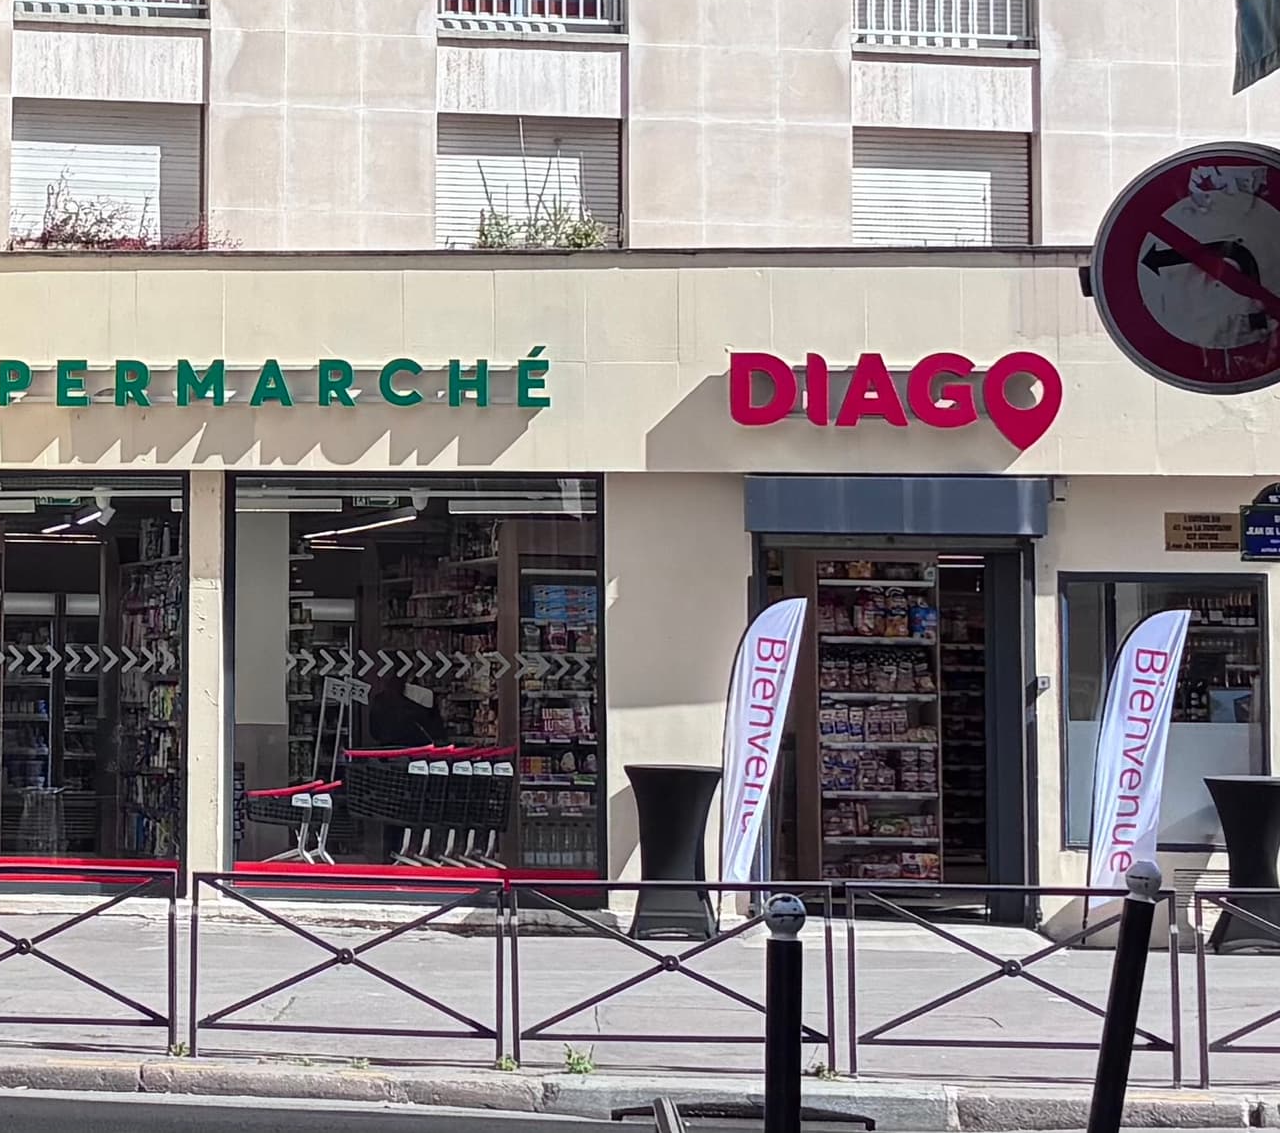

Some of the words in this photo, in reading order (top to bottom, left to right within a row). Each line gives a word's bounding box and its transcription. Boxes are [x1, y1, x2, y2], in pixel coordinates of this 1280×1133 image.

[729, 351, 1063, 452] DIAGO
[1246, 526, 1264, 536] JEAN
[1264, 526, 1275, 536] DE
[1110, 648, 1170, 873] Bienvenue
